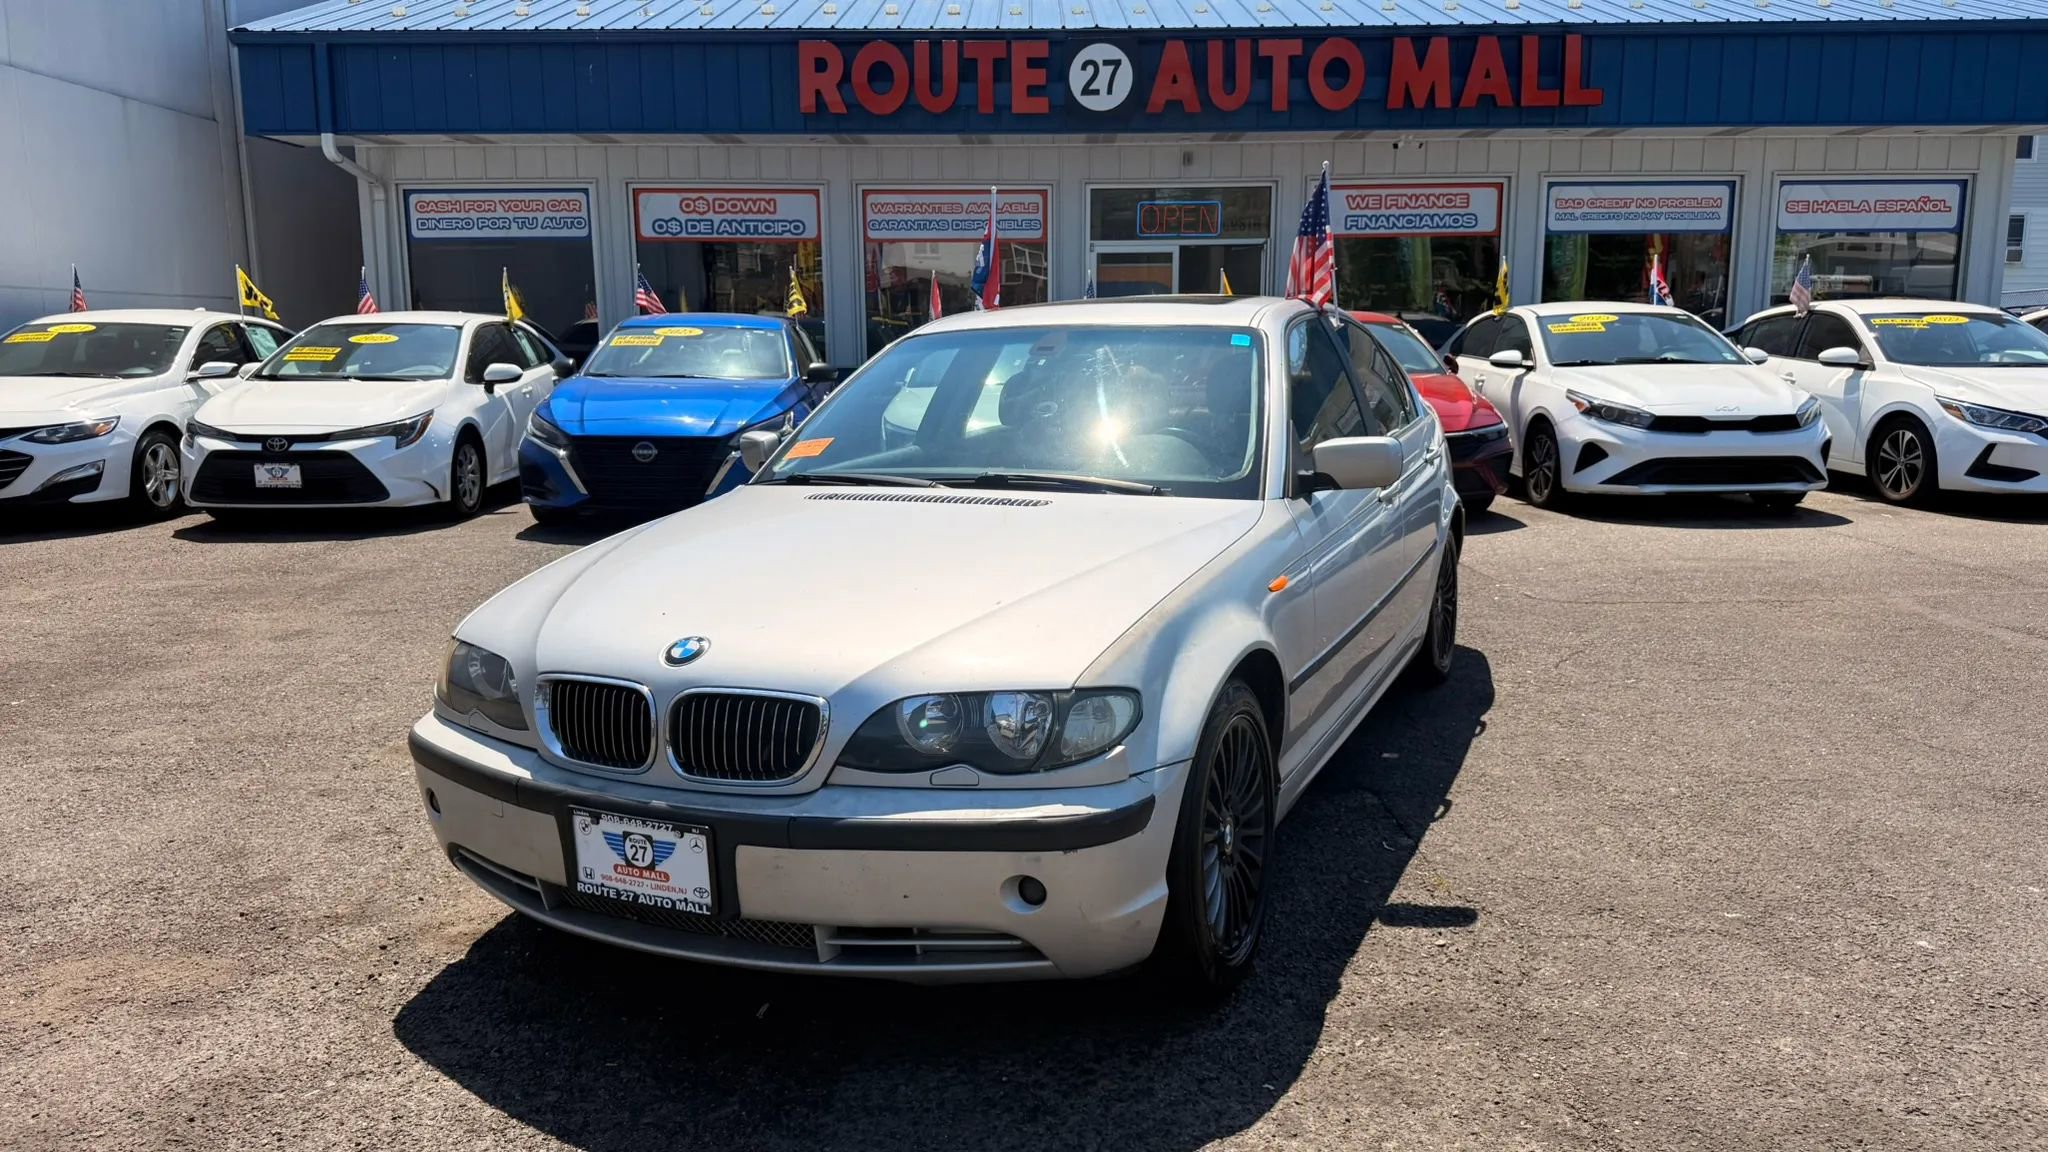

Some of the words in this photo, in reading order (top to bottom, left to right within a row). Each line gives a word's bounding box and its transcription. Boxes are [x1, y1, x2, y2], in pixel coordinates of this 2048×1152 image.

[799, 40, 1049, 115] ROUTE
[1080, 58, 1122, 96] 27
[1145, 37, 1366, 113] AUTO
[1386, 34, 1604, 109] MALL
[415, 200, 461, 213] CASH
[464, 200, 497, 213] FOR
[500, 199, 544, 212] YOUR
[547, 199, 582, 212] CAR
[713, 198, 777, 214] DOWN
[871, 202, 963, 214] WARRANTIES
[965, 202, 1040, 214] AVALABLE
[1345, 194, 1381, 210] WE
[1384, 193, 1470, 209] FINANCE
[1555, 197, 1585, 209] BAD
[1586, 197, 1635, 209] CREDIT
[1635, 197, 1657, 208] NO
[1658, 197, 1722, 209] PROBLEM
[1785, 201, 1810, 214] SE
[1811, 200, 1870, 213] HABLA
[1874, 195, 1952, 213] ESPAÑOL
[416, 217, 474, 231] DINERO
[477, 217, 511, 231] POR
[513, 217, 538, 230] TU
[541, 216, 587, 230] AUTO
[1140, 205, 1218, 233] OPEN
[1345, 212, 1477, 230] FINANCIAMOS
[1624, 212, 1640, 221] NO
[1640, 212, 1664, 221] HAY
[1664, 211, 1721, 221] PROBLEMA
[685, 219, 715, 235] DE
[717, 219, 806, 236] ANTICIPO
[868, 218, 949, 231] GARANTIAS
[628, 837, 648, 846] ROUTE
[630, 844, 648, 863] 27
[617, 866, 640, 876] AUTO
[642, 869, 667, 881] MALL
[577, 882, 617, 899] ROUTE
[620, 891, 633, 903] 27
[638, 894, 672, 908] AUTO
[676, 900, 712, 916] MALL
